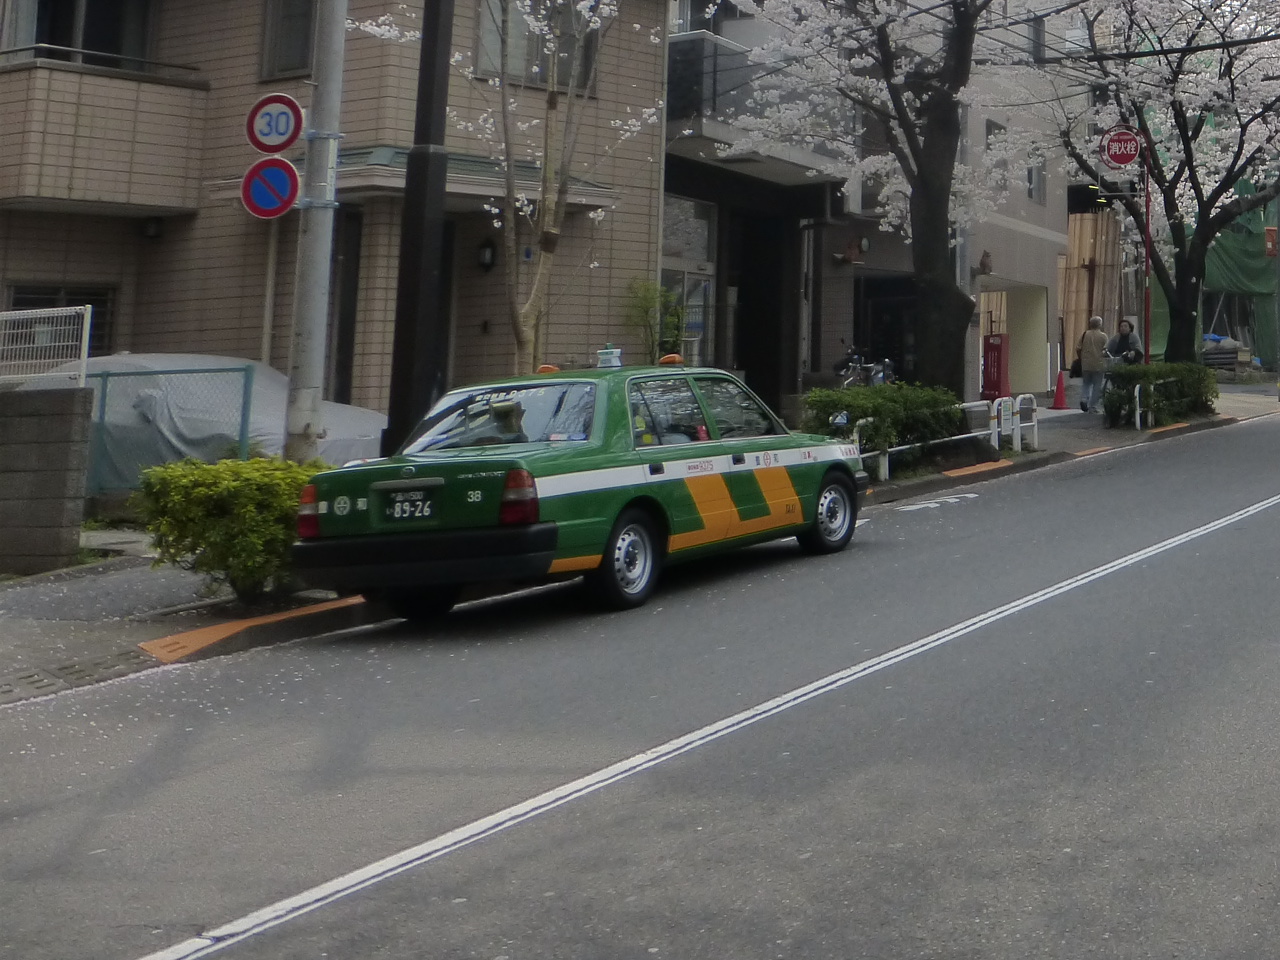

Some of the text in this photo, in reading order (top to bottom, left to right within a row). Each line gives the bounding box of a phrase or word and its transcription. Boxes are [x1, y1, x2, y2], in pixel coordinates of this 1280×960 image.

[259, 111, 290, 137] 30
[1109, 140, 1137, 155] 消火栓
[467, 491, 482, 502] 38
[394, 500, 432, 518] 89-26
